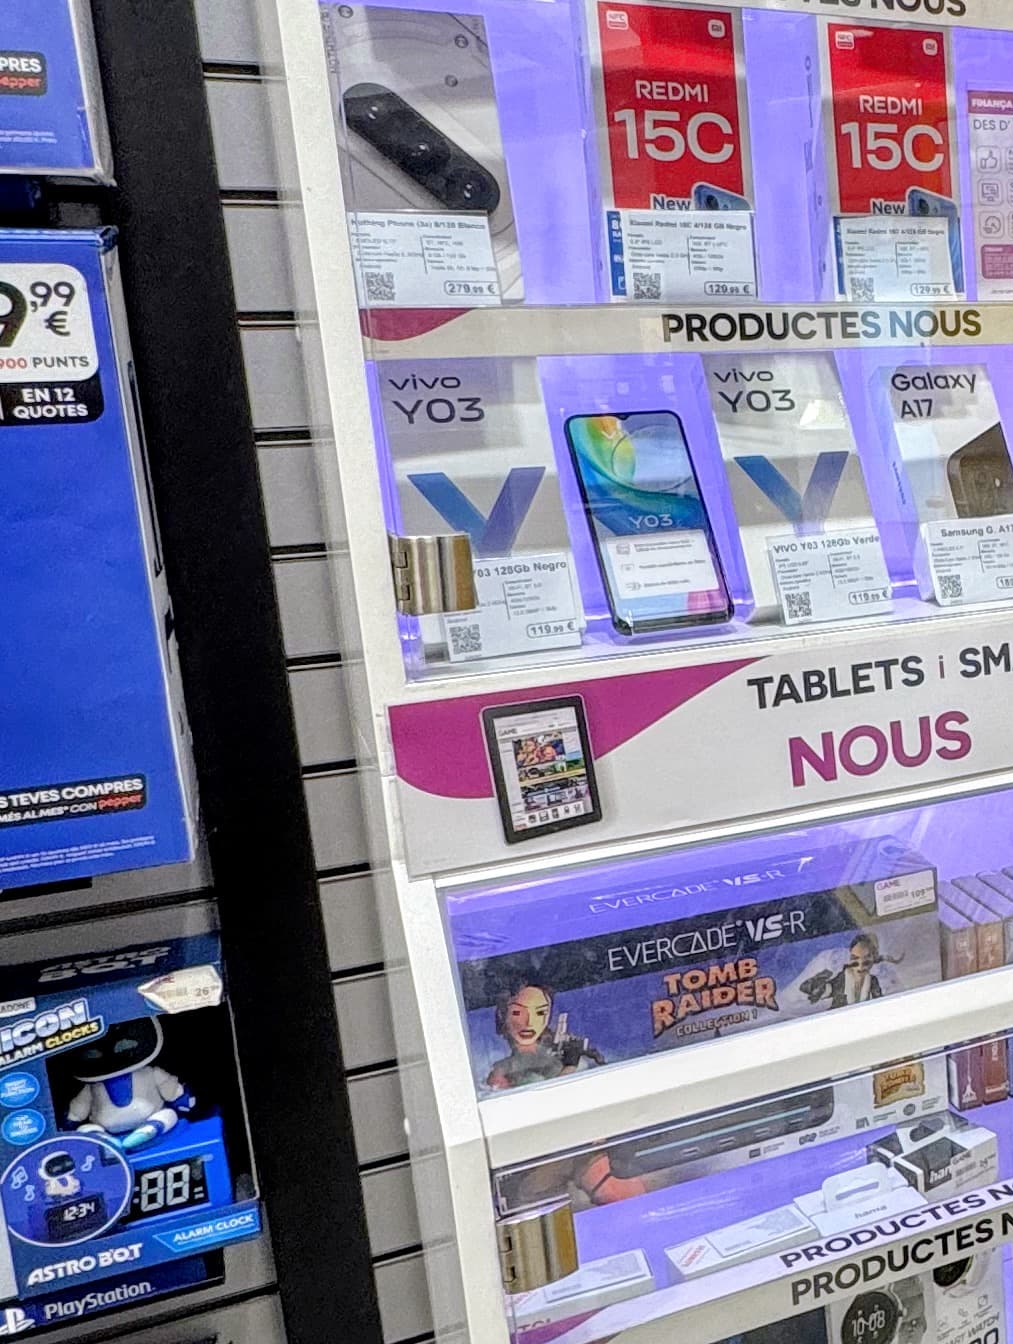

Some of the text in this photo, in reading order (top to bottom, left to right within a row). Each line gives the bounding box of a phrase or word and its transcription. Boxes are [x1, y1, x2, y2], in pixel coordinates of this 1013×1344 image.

[634, 79, 710, 104] REDMI
[859, 94, 923, 115] REDMI
[614, 109, 735, 164] 15C
[973, 119, 996, 131] DES
[840, 122, 945, 172] 15C
[653, 196, 692, 212] New
[872, 200, 906, 216] New
[44, 310, 71, 338] €
[663, 309, 982, 344] PRODUCTES NOUS
[33, 355, 89, 369] PUNTS
[388, 374, 460, 391] vivo
[713, 369, 774, 383] vivo
[891, 372, 977, 395] Galaxy
[22, 387, 75, 403] EN 12
[719, 389, 795, 413] Y03
[13, 403, 88, 420] QUOTES
[392, 397, 485, 424] Y03
[900, 399, 933, 419] A17
[629, 512, 674, 528] Y03
[941, 527, 984, 539] Samsung
[773, 543, 798, 554] VIVO
[533, 561, 567, 573] Negro
[747, 655, 925, 711] TABLETS
[788, 710, 973, 789] NOUS
[12, 778, 144, 808] TEVES COMPRES
[70, 791, 143, 814] CON pepper
[589, 881, 713, 915] EVERCADE
[608, 910, 807, 973] EVERCADE VS-R
[663, 957, 758, 996] TOMB
[651, 976, 780, 1039] RAIDER
[45, 1022, 99, 1050] CLOCKS
[676, 1013, 748, 1036] COLLECTION
[173, 1213, 253, 1242] ALARM CLOCK
[779, 1187, 986, 1269] PRODUCTES
[28, 1241, 143, 1285] ASTRO BOT
[791, 1217, 994, 1307] PRODUCTES
[44, 1279, 152, 1321] PlayStation
